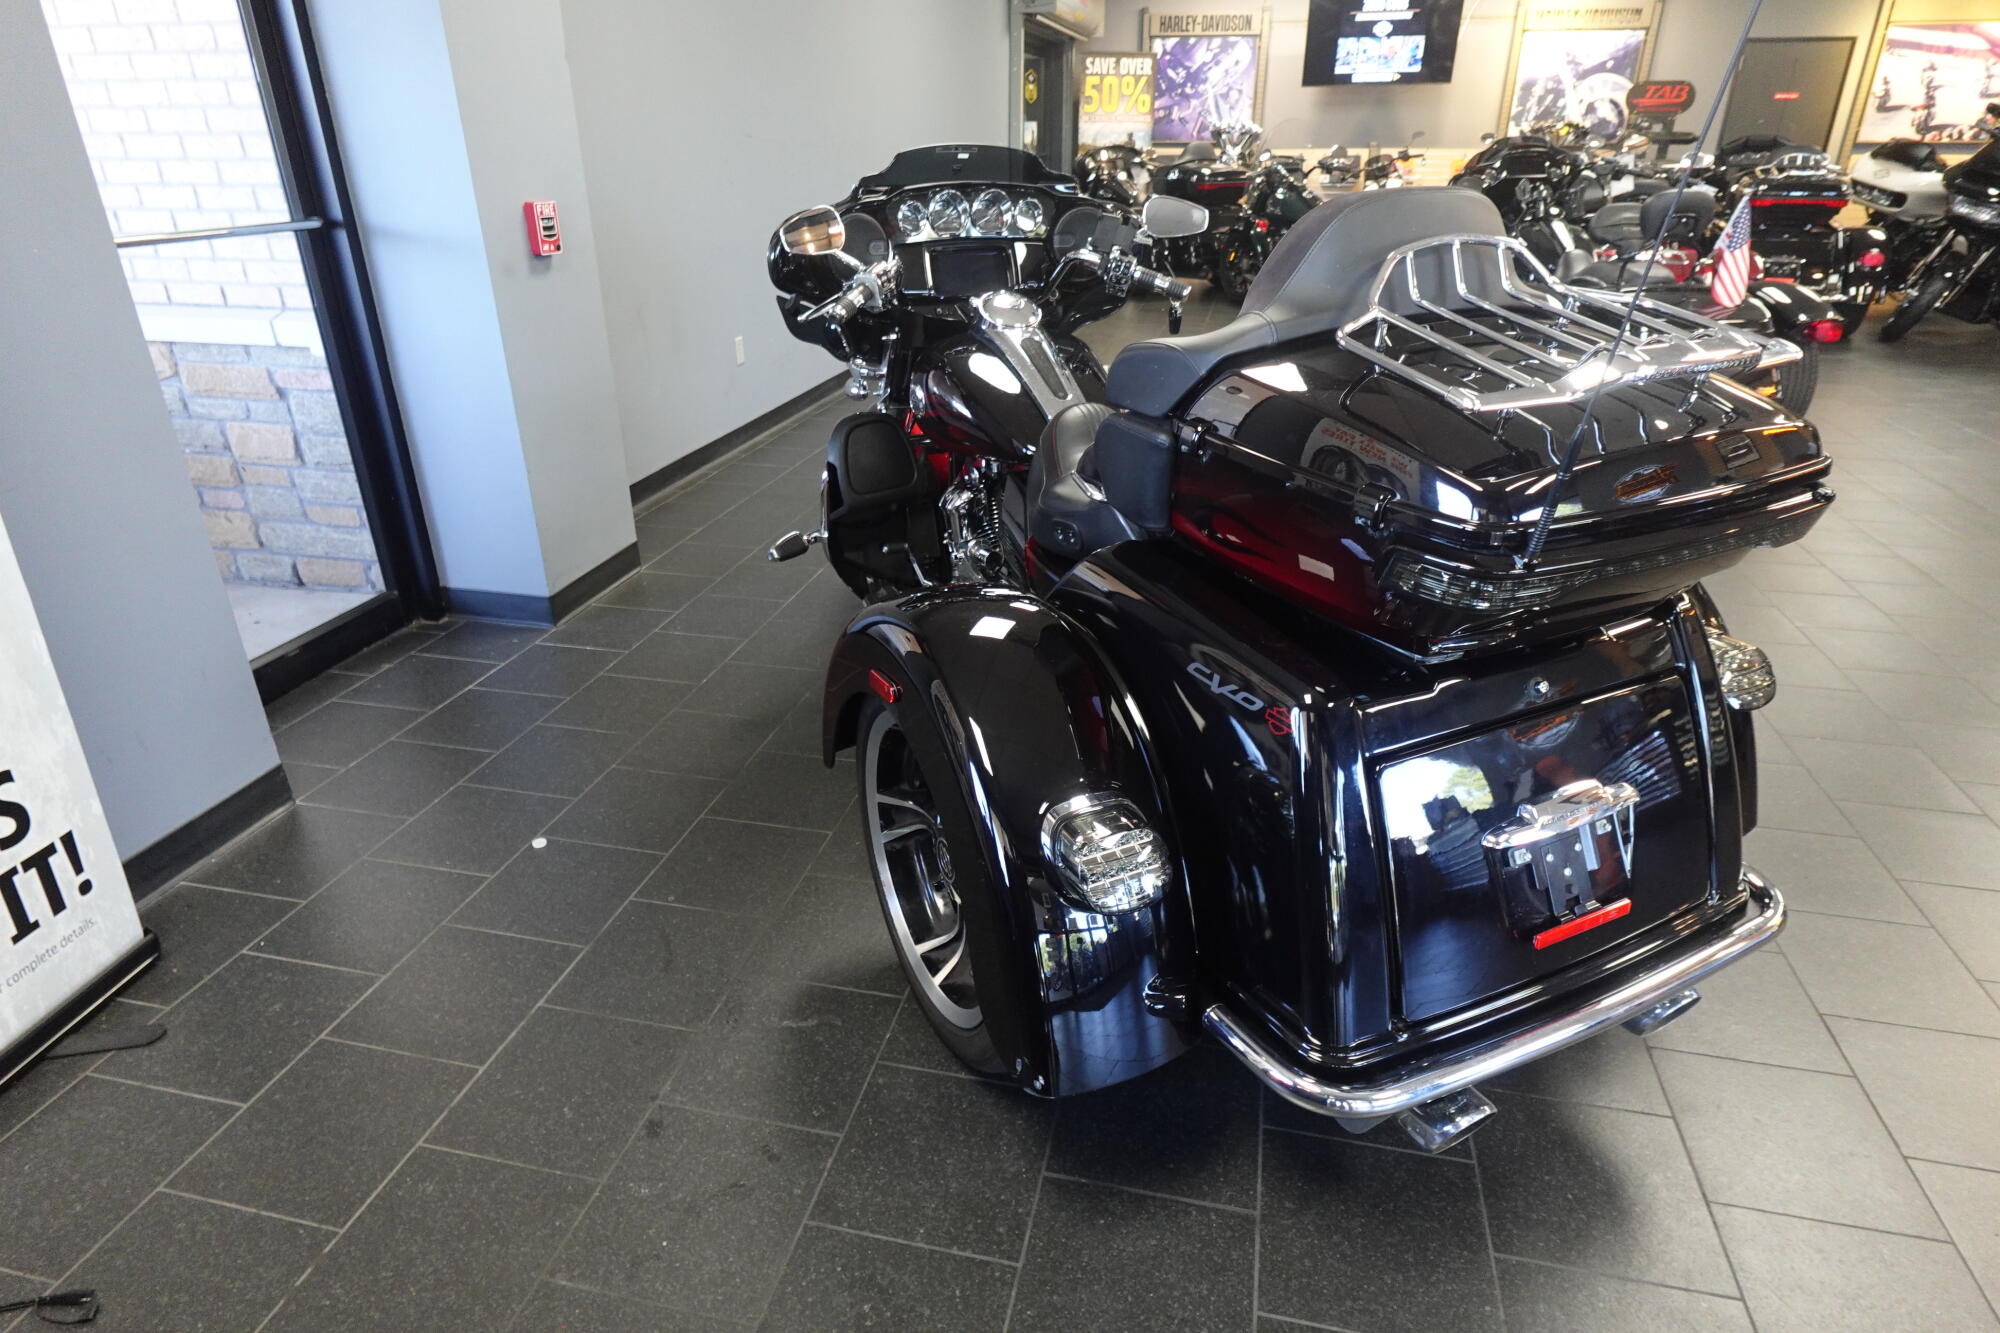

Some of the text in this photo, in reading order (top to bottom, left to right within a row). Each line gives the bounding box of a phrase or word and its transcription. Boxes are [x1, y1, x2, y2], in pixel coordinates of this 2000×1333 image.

[1160, 14, 1252, 32] HARLEY-DAVIDSON
[1085, 57, 1153, 75] SAVE OVER
[1083, 75, 1152, 113] 50%
[1186, 662, 1265, 711] CVO
[0, 830, 93, 944] IT!
[6, 944, 60, 987] complete
